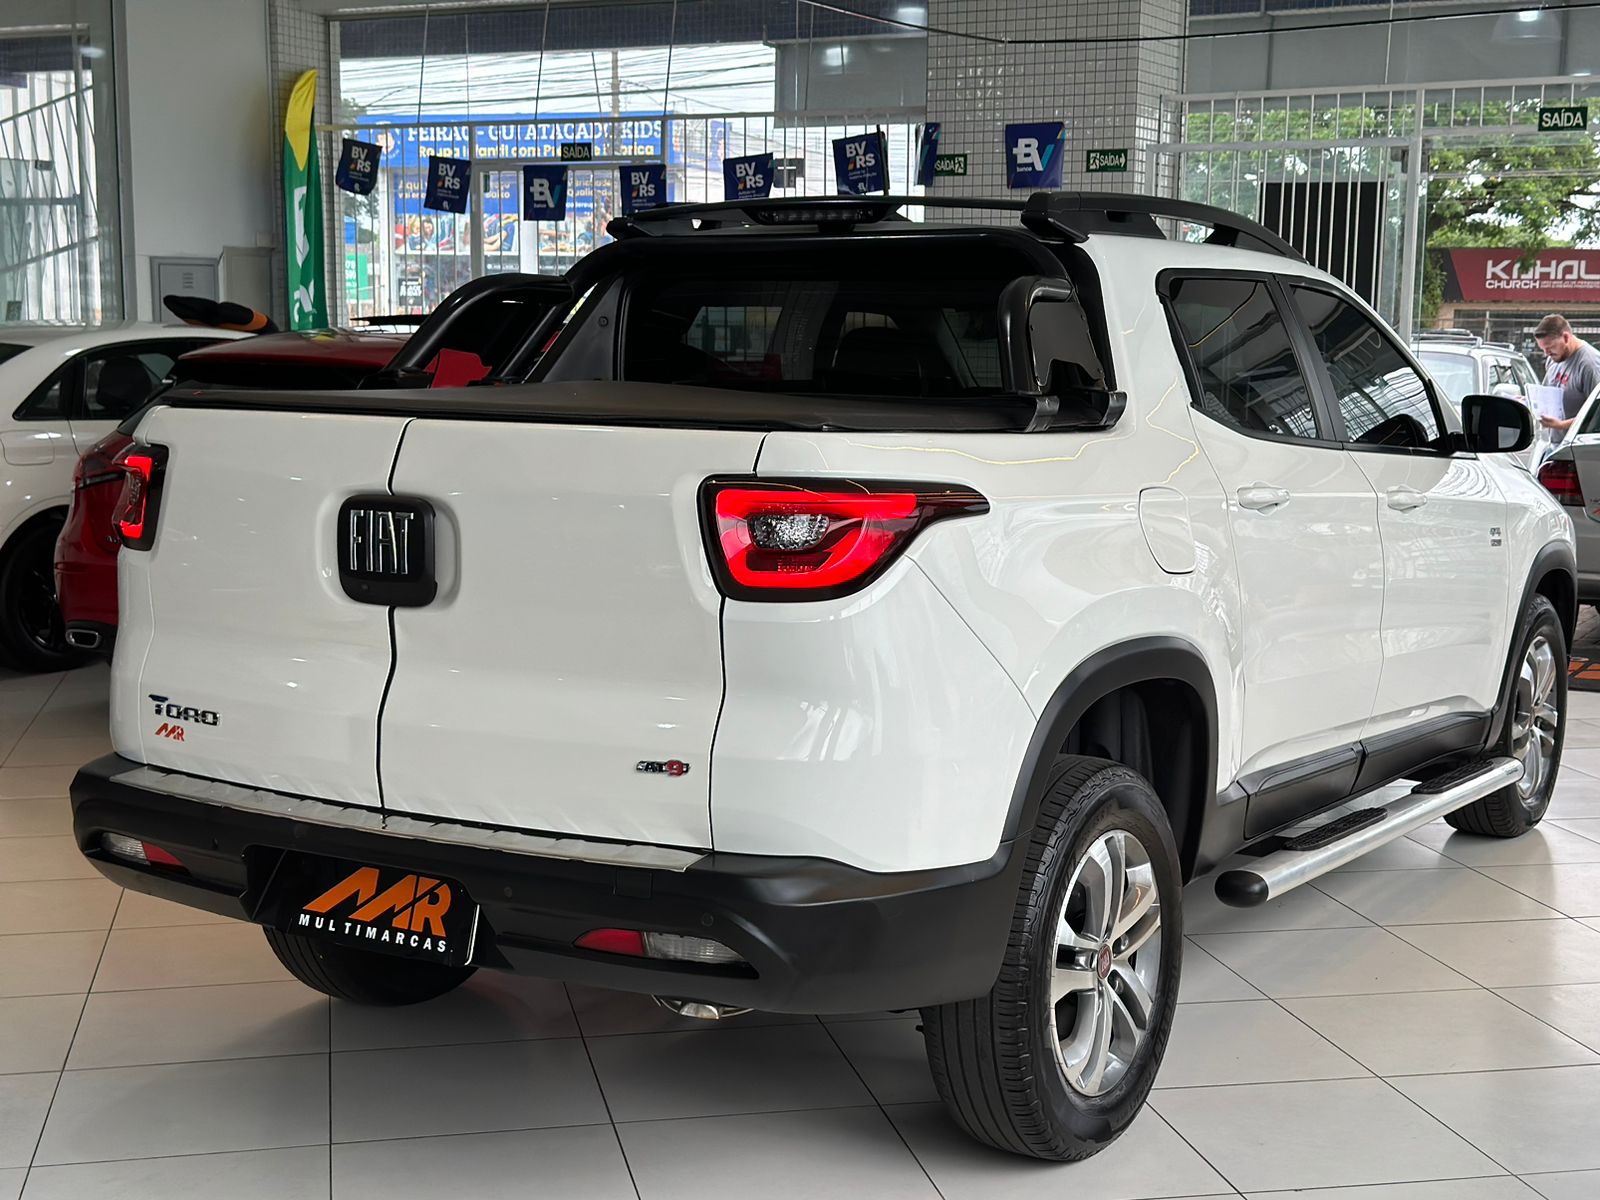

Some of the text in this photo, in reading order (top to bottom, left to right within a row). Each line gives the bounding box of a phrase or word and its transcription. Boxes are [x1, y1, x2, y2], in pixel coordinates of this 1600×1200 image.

[1541, 109, 1584, 128] SAÍDA
[620, 119, 661, 139] KIDS
[351, 146, 369, 160] BV
[511, 145, 541, 157] com
[562, 143, 591, 159] SAÍDA
[845, 141, 867, 158] BV
[356, 159, 372, 173] RS
[855, 153, 876, 169] RS
[935, 158, 955, 172] SAÍDA
[1100, 155, 1119, 168] SAÍDA
[438, 162, 457, 177] BV
[735, 162, 756, 178] BV
[444, 176, 461, 190] RS
[630, 171, 650, 186] BV
[745, 174, 765, 189] RS
[639, 184, 656, 197] RS
[1485, 280, 1540, 289] CHURCH
[350, 509, 414, 575] FIAT
[298, 913, 449, 953] MULTIMARCAS
